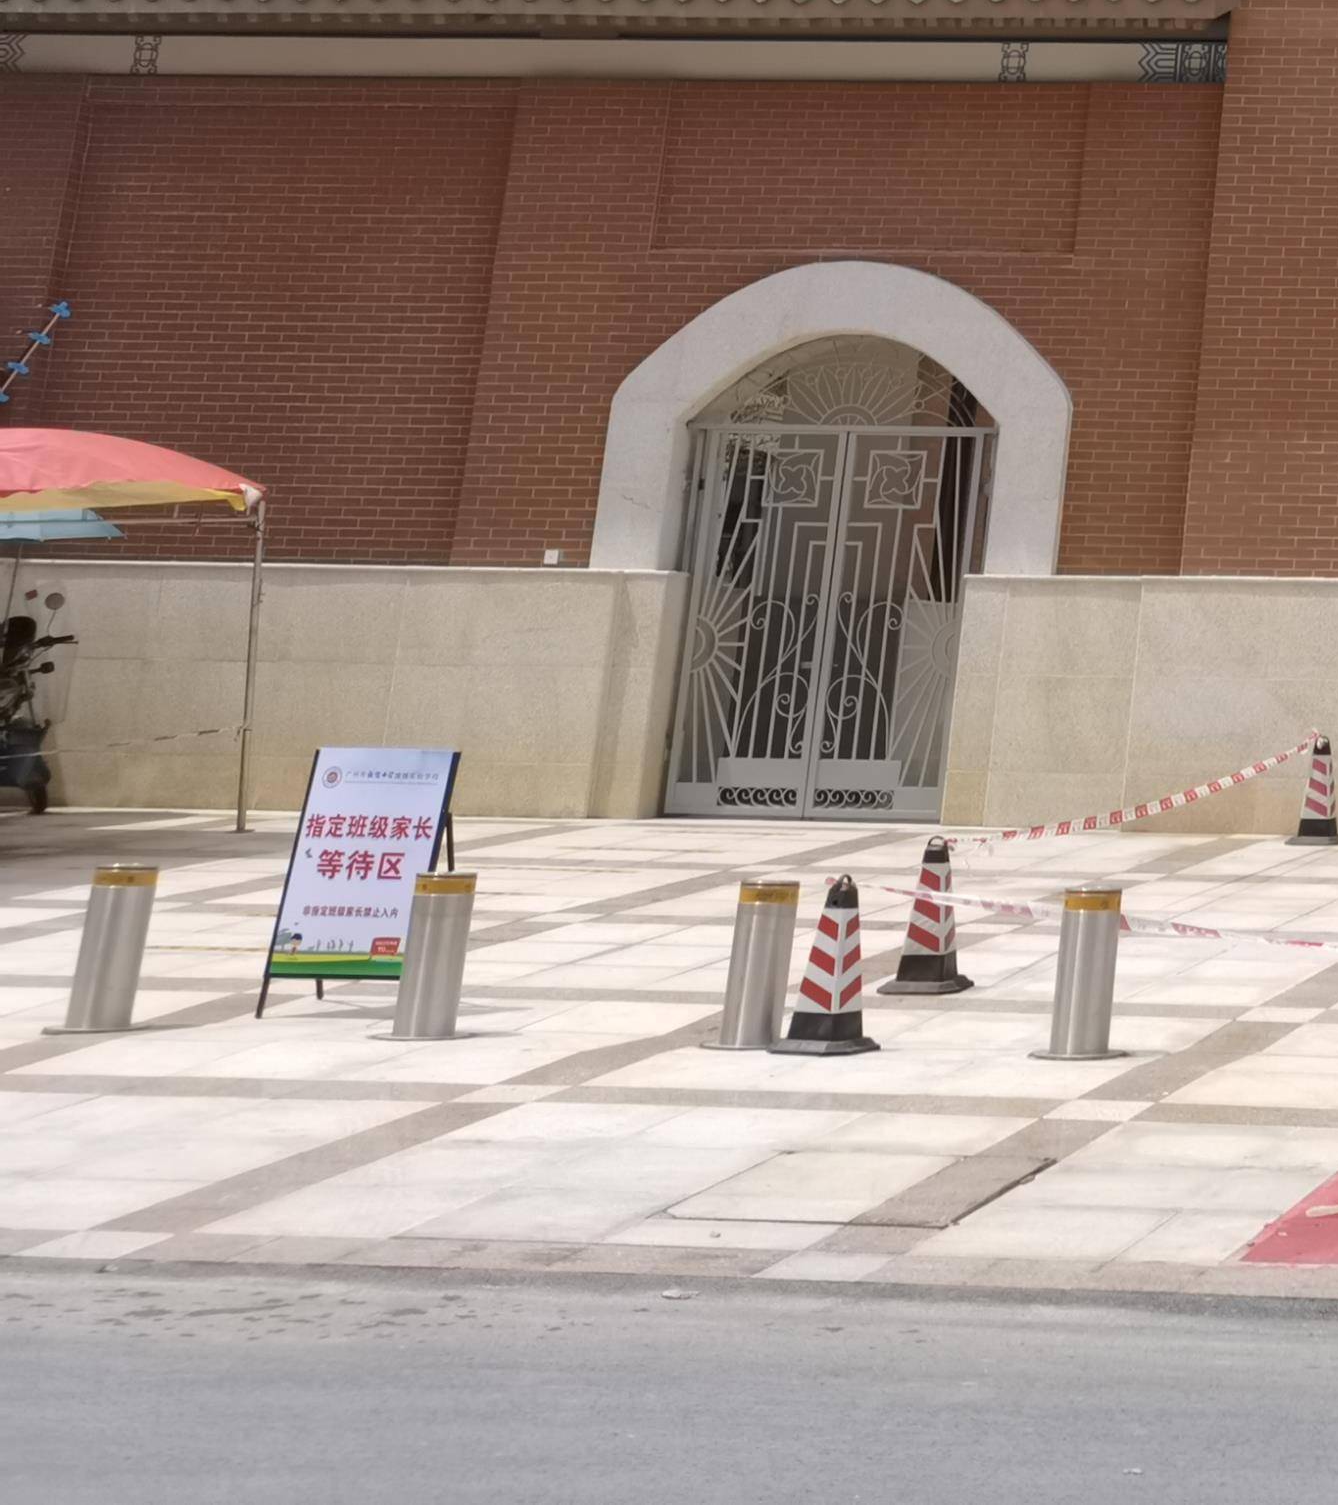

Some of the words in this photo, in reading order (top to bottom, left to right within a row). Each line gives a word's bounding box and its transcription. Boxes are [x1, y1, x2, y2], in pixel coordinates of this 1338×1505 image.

[305, 814, 433, 840] 指定班级家长
[316, 849, 405, 881] 等待区
